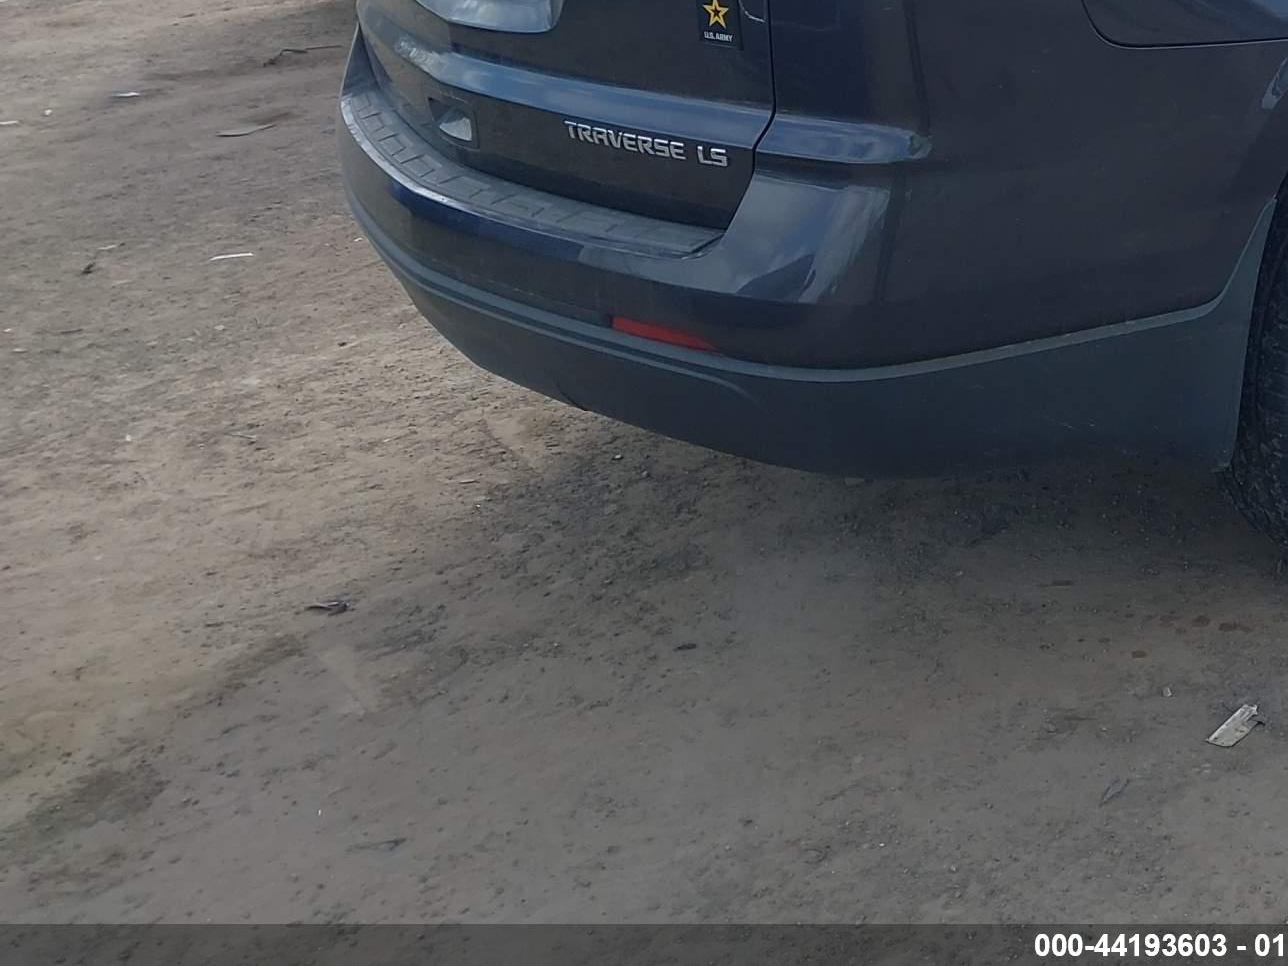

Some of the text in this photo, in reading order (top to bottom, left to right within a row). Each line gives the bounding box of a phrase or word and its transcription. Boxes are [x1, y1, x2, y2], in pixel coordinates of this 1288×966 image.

[715, 33, 733, 42] ARMY
[564, 120, 728, 167] TRAVERSE LS
